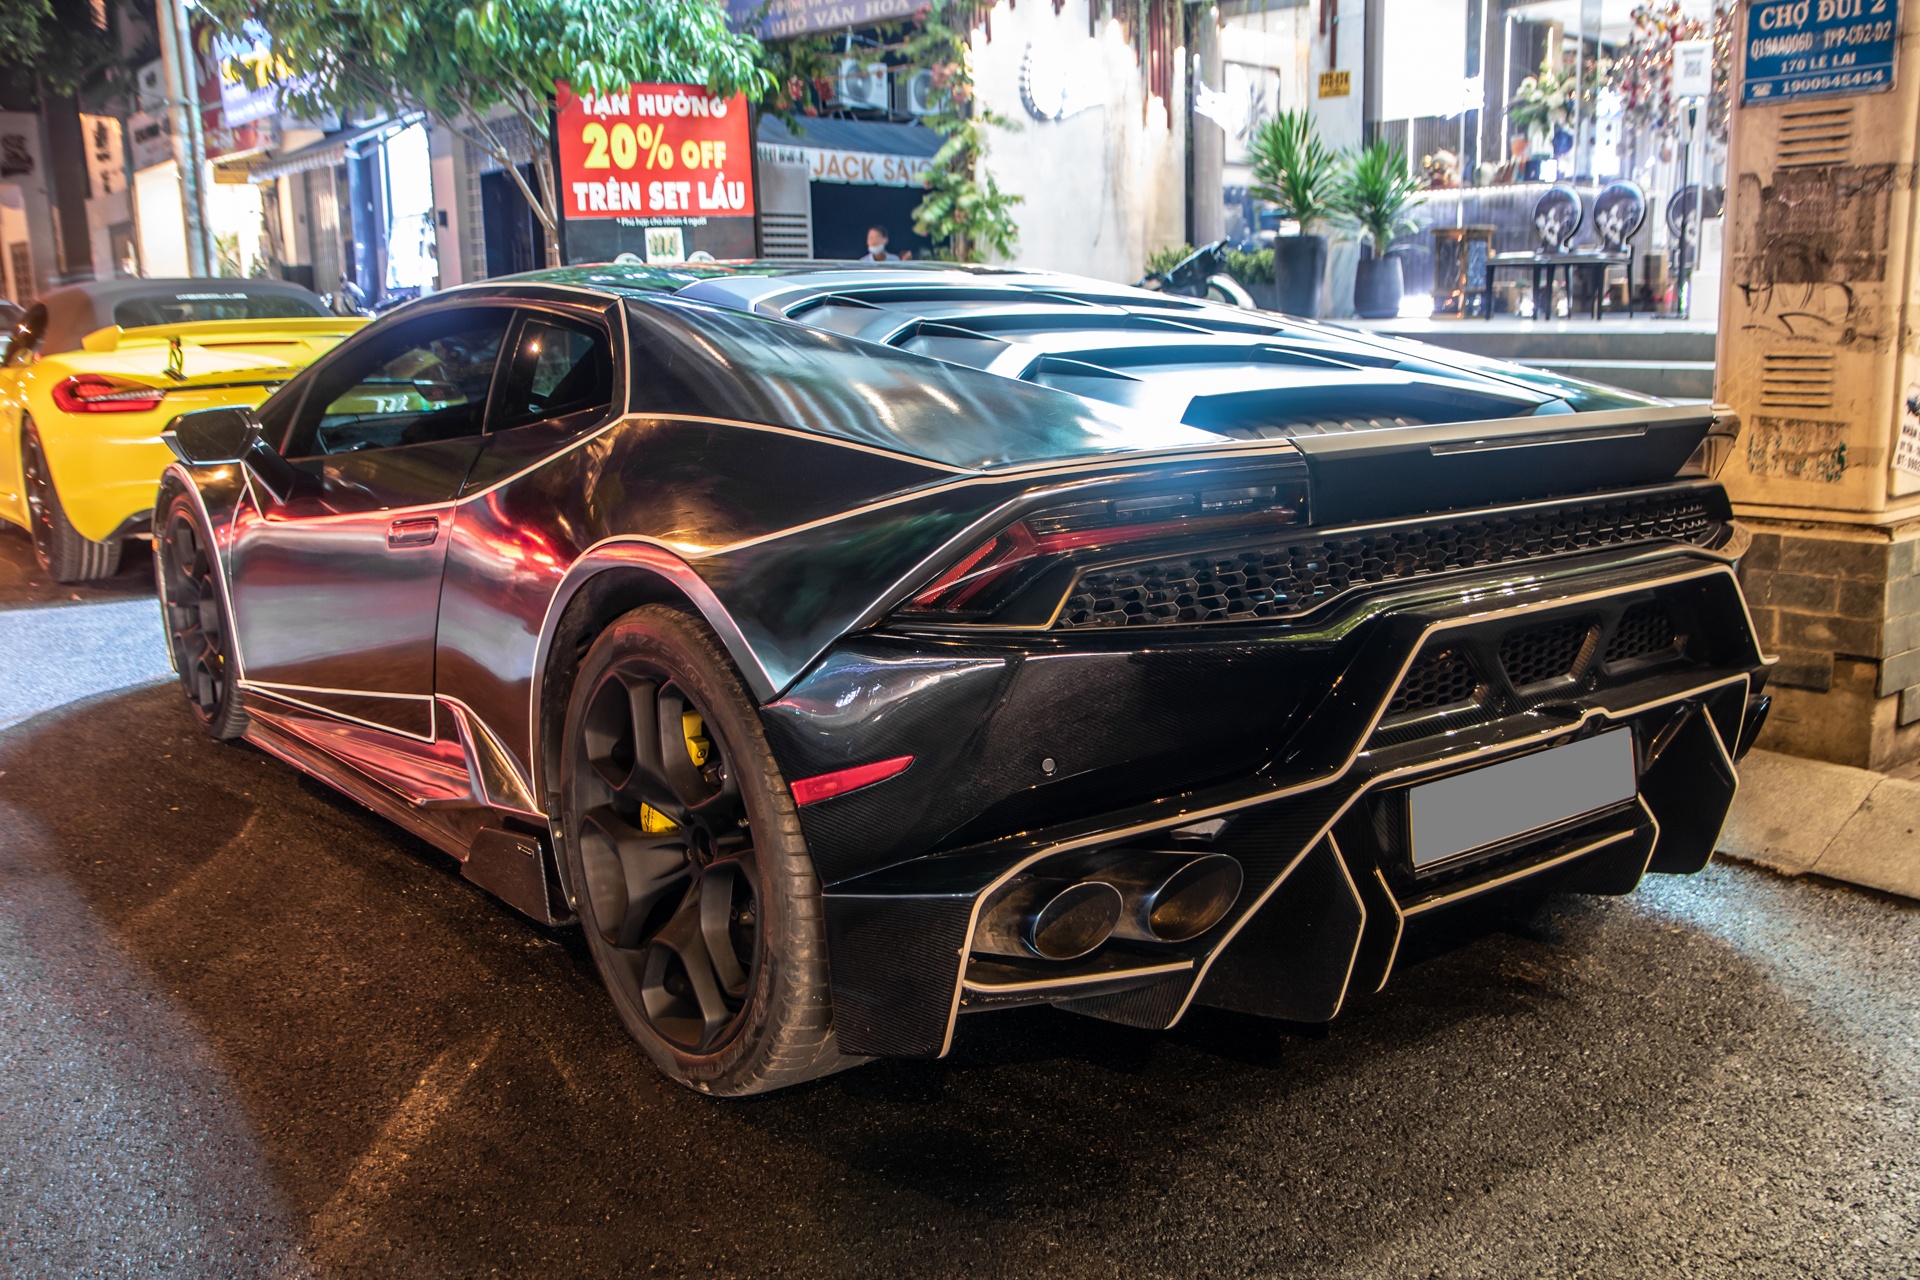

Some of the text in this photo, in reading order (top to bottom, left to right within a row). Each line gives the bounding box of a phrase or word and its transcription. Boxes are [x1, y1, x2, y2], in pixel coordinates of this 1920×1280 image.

[1759, 0, 1810, 31] CHỢ
[1781, 58, 1807, 74] 170
[1782, 69, 1884, 94] 1900545454
[637, 89, 728, 118] HƯỞNG
[582, 122, 674, 170] 20%
[680, 139, 727, 170] OFF
[813, 152, 875, 181] JACK
[572, 172, 746, 211] TRÊN SET LẨU
